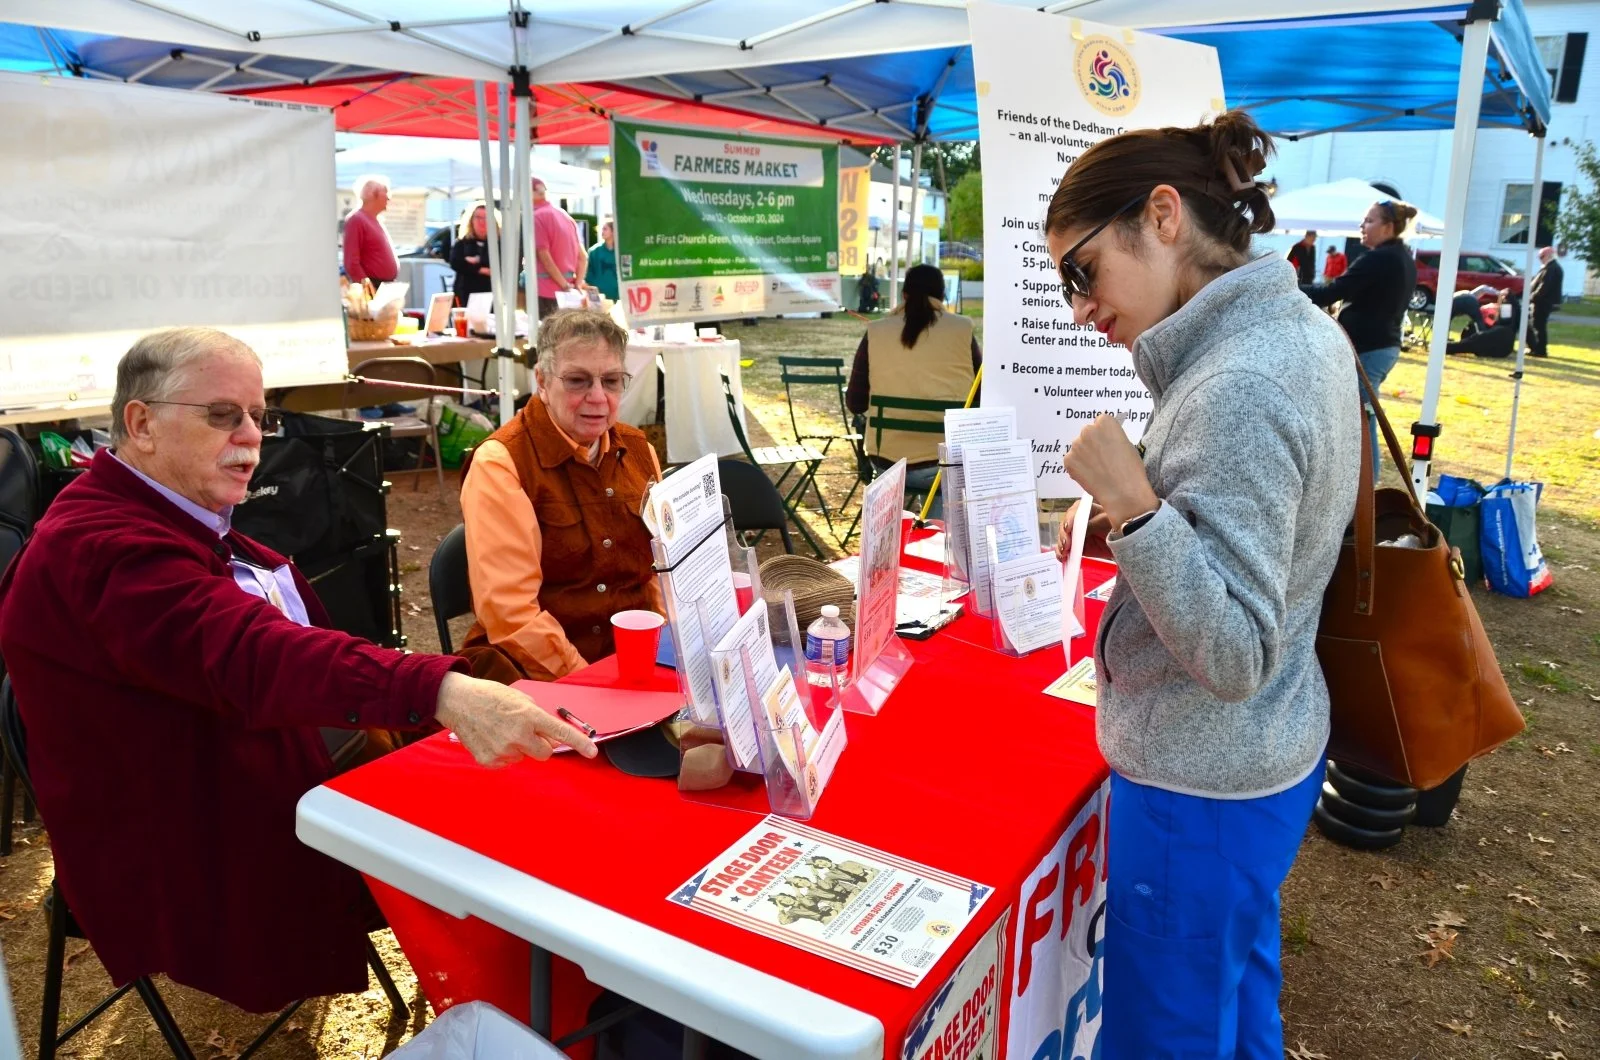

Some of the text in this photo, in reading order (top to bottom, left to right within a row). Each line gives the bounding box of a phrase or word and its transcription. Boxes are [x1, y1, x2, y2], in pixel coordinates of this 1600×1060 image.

[998, 110, 1038, 126] Friends
[1040, 116, 1051, 127] of
[1054, 118, 1070, 130] the
[1073, 120, 1116, 136] Dedham
[1018, 132, 1098, 150] an all-voluntee
[724, 143, 760, 156] SUMMER
[674, 154, 740, 175] FARMERS
[744, 160, 798, 178] MARKET
[681, 187, 794, 210] Wednesdays, 2-6 pm
[728, 214, 755, 224] October
[768, 214, 784, 224] 2024
[1002, 216, 1024, 230] Join
[1028, 220, 1040, 231] us
[644, 236, 654, 244] at
[656, 234, 676, 244] First
[677, 234, 706, 244] Church
[649, 258, 666, 266] Local
[1022, 257, 1056, 271] 55-plu
[1022, 279, 1064, 294] Suppor
[1022, 296, 1063, 308] seniors.
[1022, 317, 1050, 330] Raise
[1022, 333, 1056, 346] Center
[1058, 336, 1078, 346] and
[1080, 336, 1096, 347] the
[1012, 362, 1054, 374] Become
[1056, 366, 1062, 374] a
[1066, 365, 1106, 376] member
[1044, 386, 1093, 398] Volunteer
[1096, 388, 1122, 398] when
[1124, 390, 1142, 401] you
[1031, 440, 1060, 452] hank
[700, 832, 787, 896] STAGE DOOR
[736, 847, 801, 896] CANTEEN
[852, 912, 876, 934] OCTOBER
[871, 902, 884, 914] 30TH
[885, 883, 904, 900] 6:30PM
[874, 936, 898, 955] $30
[963, 963, 995, 1033] DOOR
